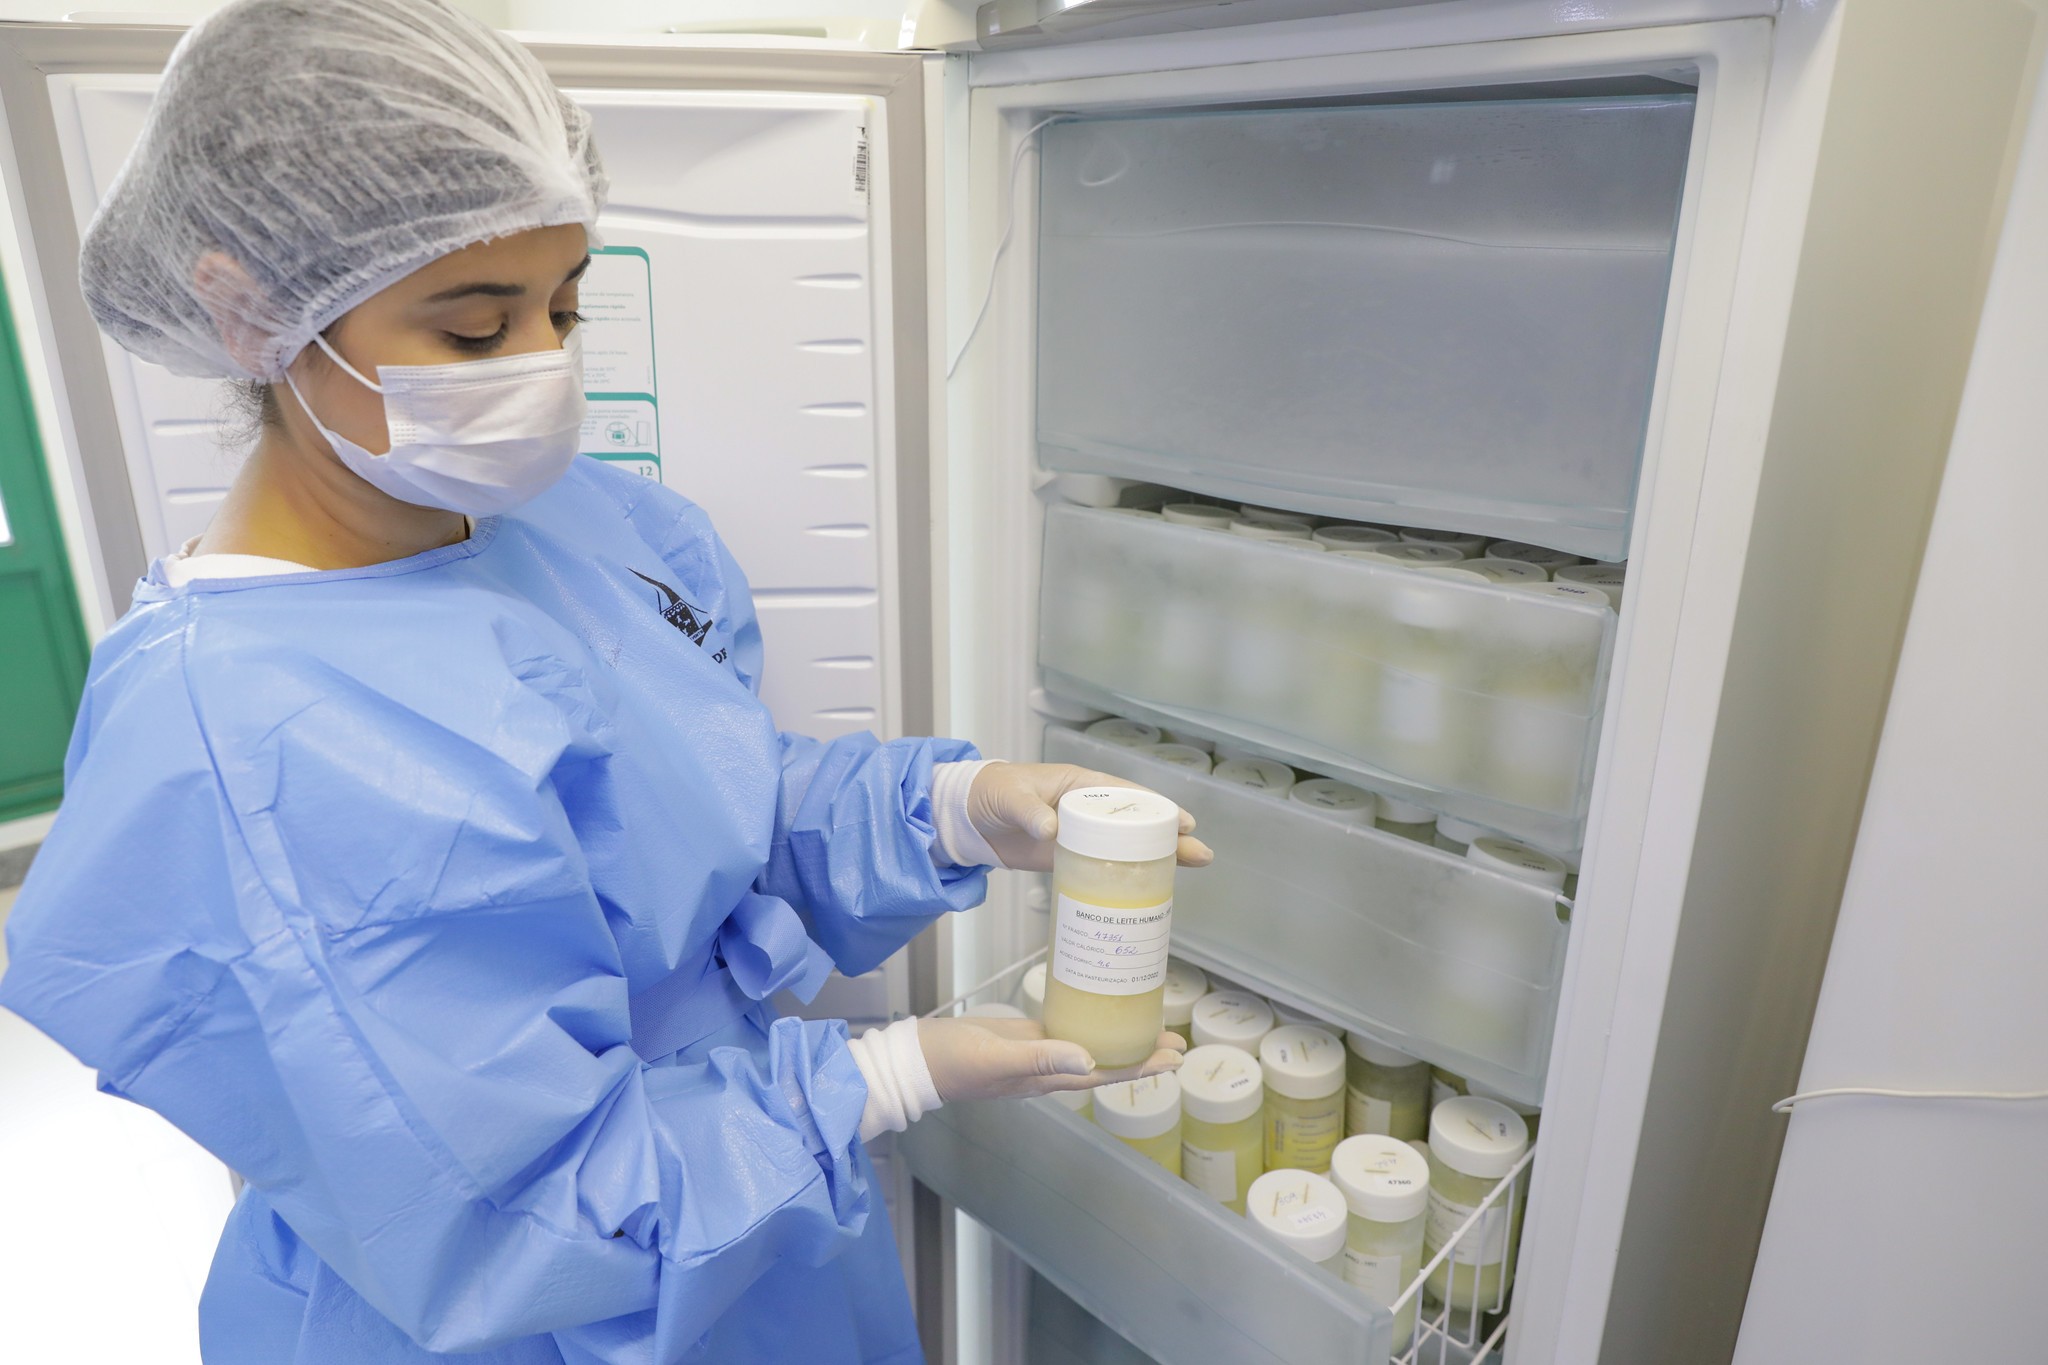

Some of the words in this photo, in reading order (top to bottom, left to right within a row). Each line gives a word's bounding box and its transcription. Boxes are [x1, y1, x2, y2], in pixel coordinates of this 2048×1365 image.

[639, 466, 653, 477] 12
[711, 647, 727, 664] DF
[1076, 909, 1102, 922] BANCO
[1103, 916, 1114, 924] DE
[1116, 917, 1138, 925] LEITE
[1067, 924, 1088, 938] FRASCO
[1114, 945, 1138, 956] 652
